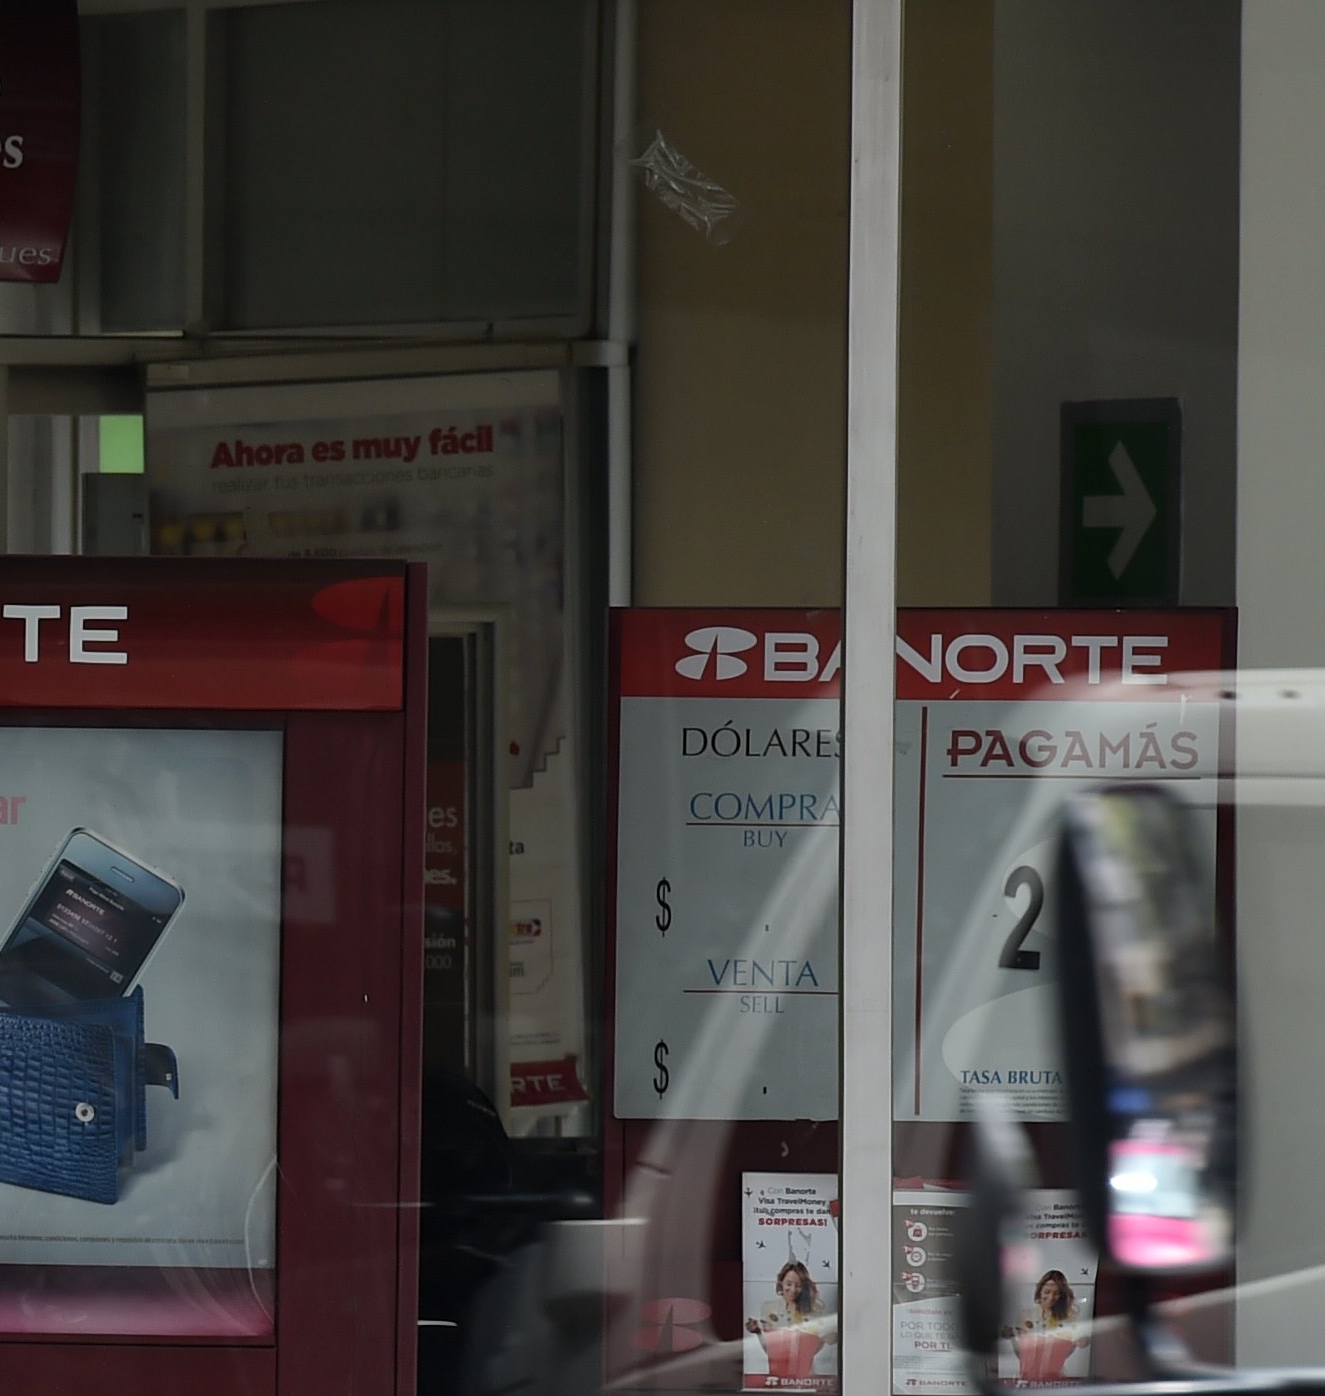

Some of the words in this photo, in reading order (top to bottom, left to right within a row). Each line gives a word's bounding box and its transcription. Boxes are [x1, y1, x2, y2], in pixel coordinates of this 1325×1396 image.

[211, 441, 304, 468] Ahora
[312, 442, 345, 461] es
[353, 436, 421, 462] muy
[429, 425, 493, 456] fácil
[947, 722, 1199, 770] PAGAMÁS
[689, 793, 839, 821] COMPRA
[743, 831, 788, 849] BUY
[707, 959, 819, 988] VENTA
[740, 996, 784, 1014] SELL
[961, 1070, 1001, 1084] TASA
[1007, 1070, 1062, 1085] BRUTA
[759, 1218, 828, 1227] SORPRESAS!
